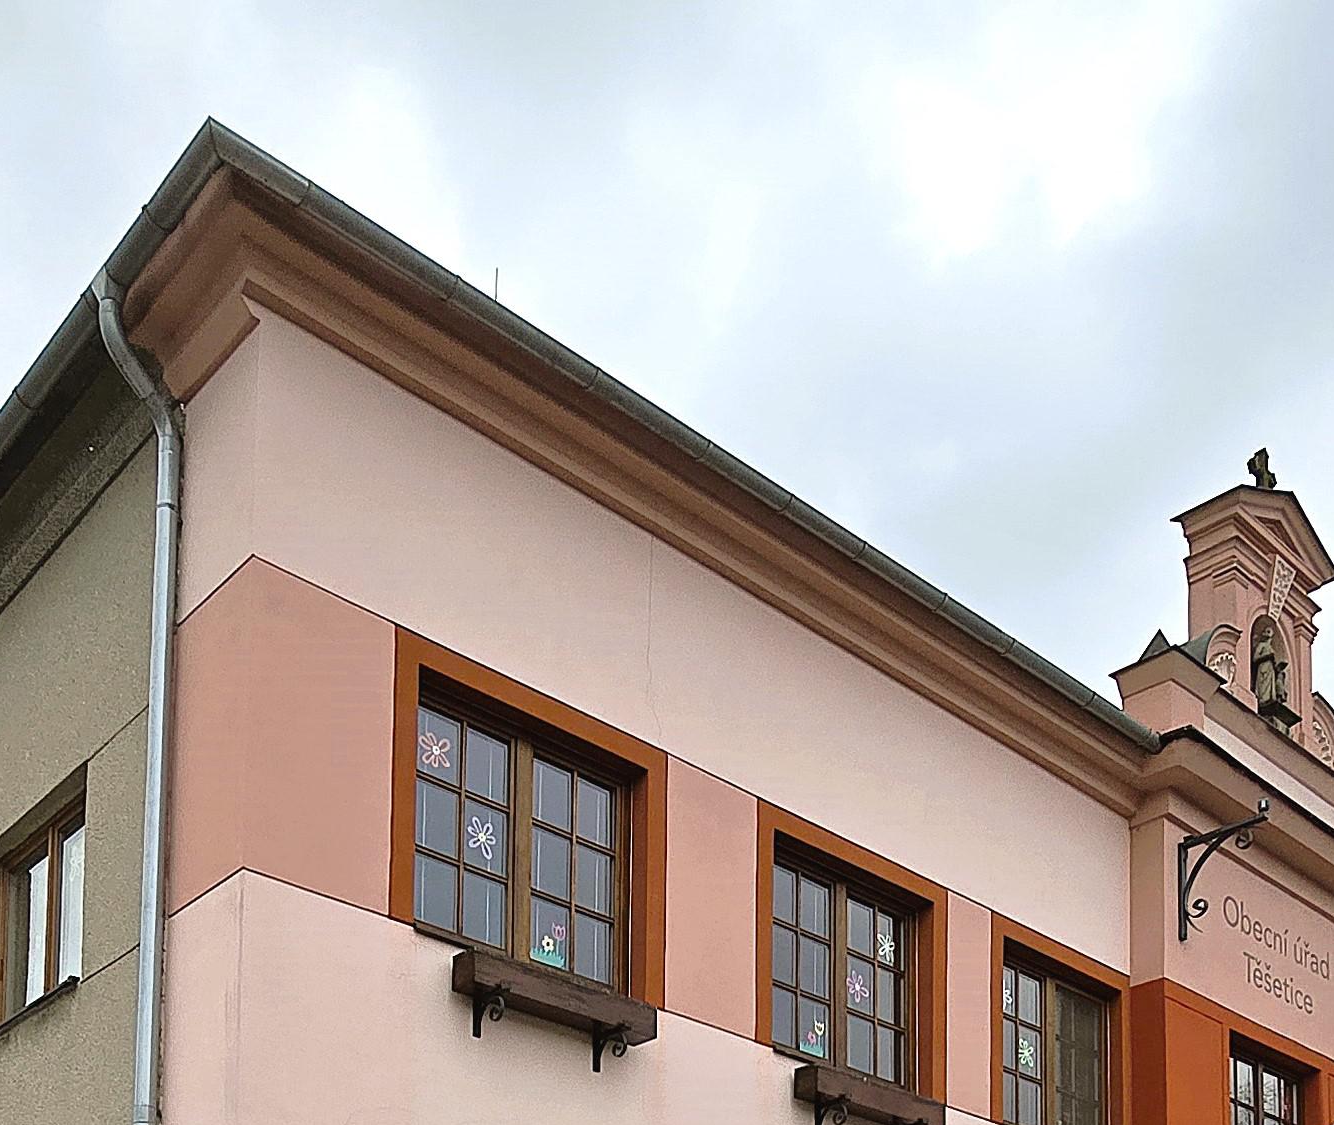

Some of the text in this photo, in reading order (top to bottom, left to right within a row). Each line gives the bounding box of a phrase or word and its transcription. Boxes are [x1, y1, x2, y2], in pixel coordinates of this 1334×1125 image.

[1223, 895, 1330, 981] Obecní úřad
[1242, 951, 1313, 1014] Těšetice
